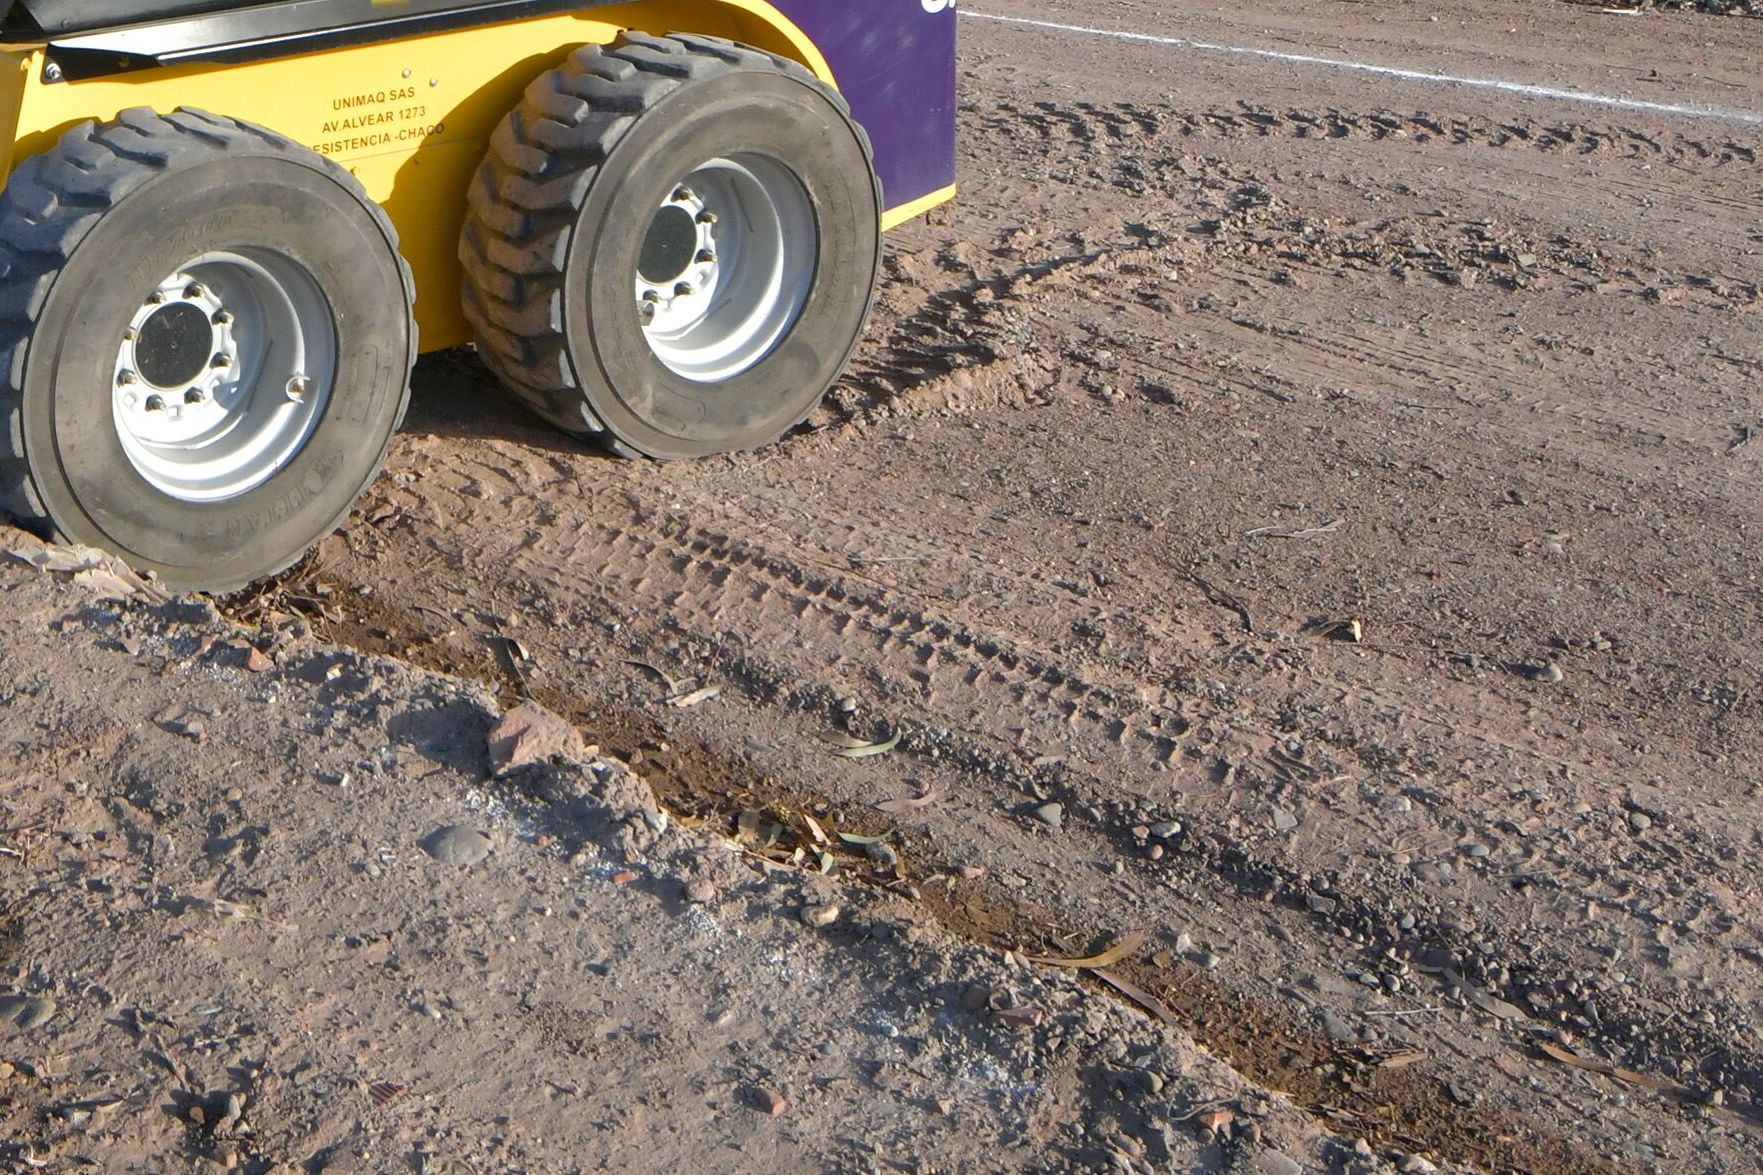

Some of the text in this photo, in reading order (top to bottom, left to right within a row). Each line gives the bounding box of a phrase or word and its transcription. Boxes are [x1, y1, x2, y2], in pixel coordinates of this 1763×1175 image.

[333, 86, 415, 111] UNIMAQ SAS
[399, 105, 426, 121] 1273
[312, 132, 391, 155] ESISTENCIA
